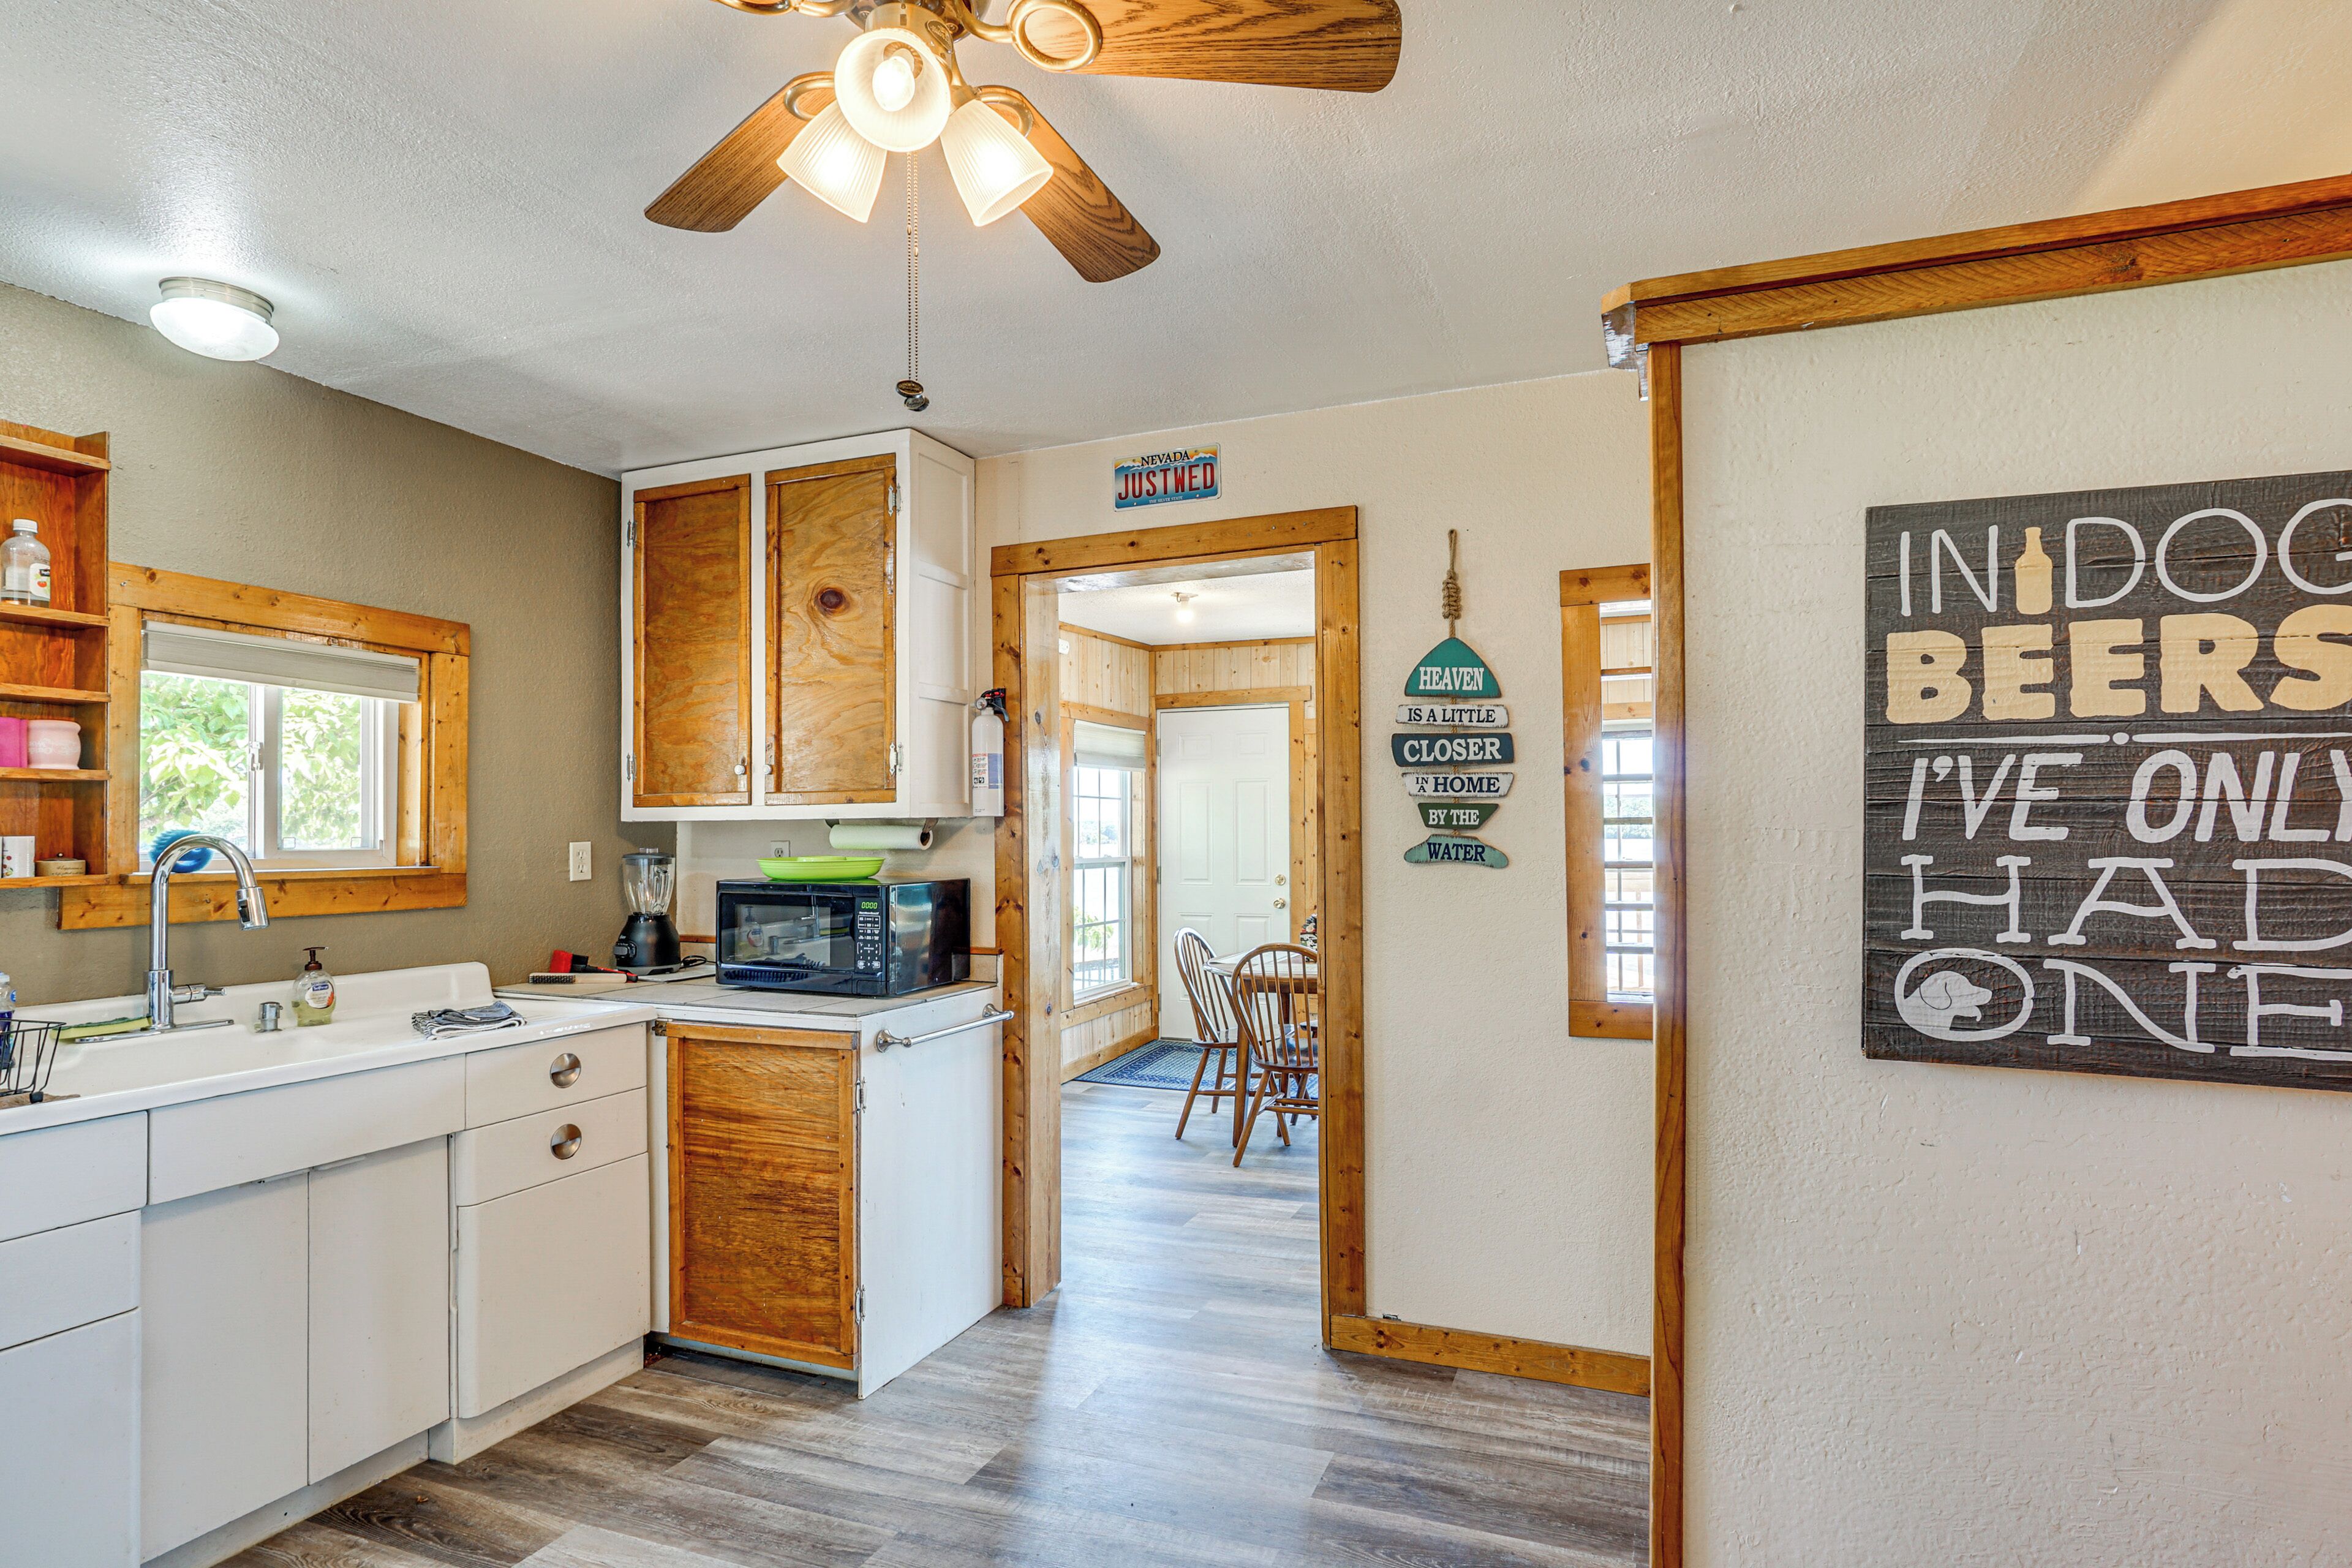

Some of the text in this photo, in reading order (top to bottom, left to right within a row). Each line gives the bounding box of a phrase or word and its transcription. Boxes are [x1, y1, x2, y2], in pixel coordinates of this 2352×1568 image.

[1140, 450, 1191, 467] NEVADA
[1118, 462, 1215, 500] JUSTWED
[1901, 498, 2352, 616] IN DOG
[1885, 604, 2352, 724] BEERS
[1419, 666, 1484, 691] HEAVEN
[1408, 707, 1496, 723] IS A LITTLE
[1403, 737, 1502, 763] CLOSER
[1415, 777, 1429, 785] IN
[1433, 777, 1500, 793] HOME
[1902, 752, 2082, 841] I'VE
[1428, 809, 1480, 826] BY THE
[1427, 842, 1486, 862] WATER
[1901, 854, 2352, 951] HAD
[1894, 948, 2352, 1062] ONE
